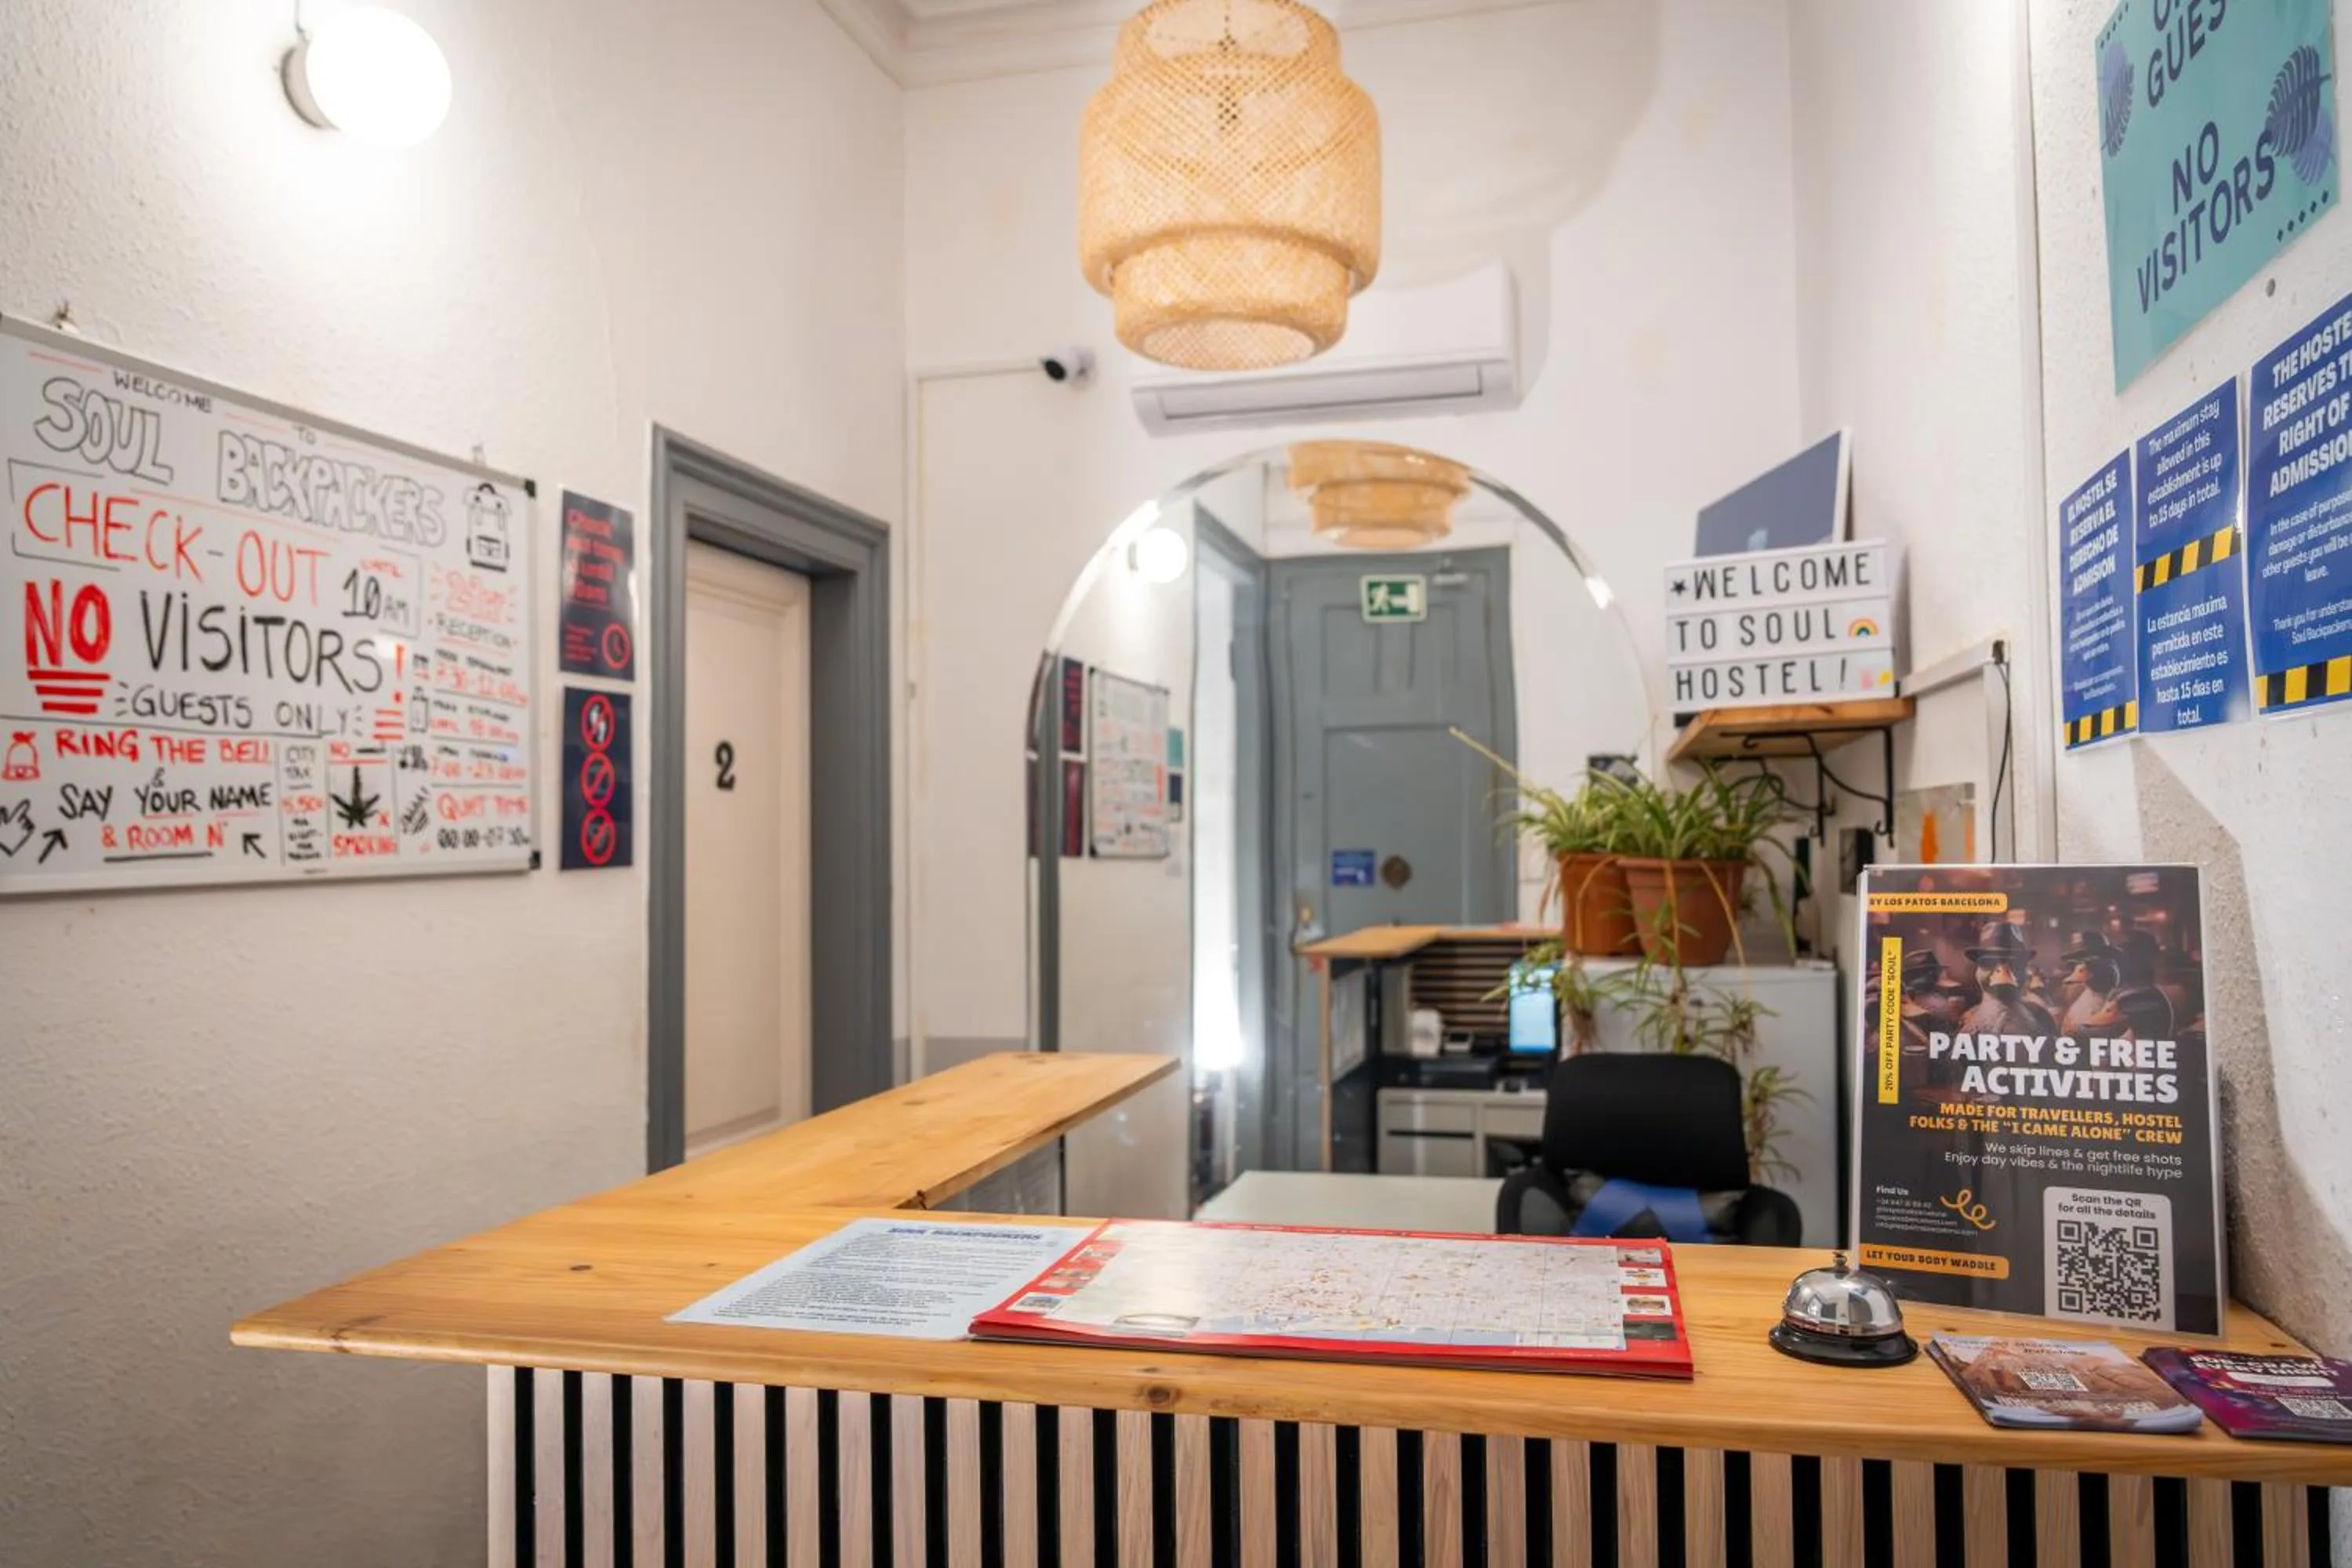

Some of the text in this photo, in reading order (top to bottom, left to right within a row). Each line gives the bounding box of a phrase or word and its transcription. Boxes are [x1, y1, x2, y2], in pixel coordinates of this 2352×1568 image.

[2172, 121, 2220, 215] NO
[2137, 128, 2275, 314] VISITORS
[2273, 348, 2299, 389] THE
[113, 370, 212, 414] WELCOME
[2263, 361, 2337, 430] RESERVES
[2200, 399, 2220, 423] stay
[2279, 392, 2350, 456] RIGHT OF
[33, 376, 174, 486] SOUL
[2157, 430, 2211, 477] allowed in this
[216, 430, 447, 547] BACKPACKERS
[2105, 470, 2118, 493] SE
[2147, 452, 2223, 505] establishment is up
[2149, 511, 2158, 528] to
[2158, 504, 2168, 524] 15
[2169, 497, 2188, 520] days
[2188, 490, 2196, 508] in
[2106, 524, 2118, 548] DE
[342, 568, 382, 619] 10
[1694, 552, 1871, 601] WELCOME
[24, 577, 112, 668] NO
[140, 590, 383, 694] VISITORS
[1675, 608, 1836, 652] TO SOUL
[2147, 617, 2157, 633] La
[2157, 604, 2190, 628] estancia
[2152, 623, 2224, 660] permitida en este
[2151, 652, 2216, 681] establecimiento
[2216, 650, 2228, 666] es
[132, 684, 252, 730] GUESTS
[2157, 686, 2180, 704] hasta
[2180, 681, 2190, 699] 15
[2212, 678, 2224, 696] en
[55, 728, 140, 763] RING
[151, 735, 205, 765] THE
[714, 740, 735, 791] 2
[59, 782, 272, 822] SAY YOUR NAME
[102, 824, 118, 848] &
[127, 823, 194, 852] ROOM
[1886, 989, 1895, 1014] CODE
[1886, 1018, 1895, 1047] PARTY
[1929, 1032, 2176, 1069] PARTY & FREE
[1886, 1051, 1894, 1070] OFF
[1885, 1073, 1894, 1091] 20%
[1961, 1065, 2179, 1103] ACTIVITIES
[1909, 1116, 1955, 1130] FOLKS
[1958, 1119, 1967, 1130] &
[1972, 1120, 1999, 1132] THE
[2022, 1123, 2067, 1137] CAME
[2136, 1130, 2183, 1144] CREW
[1940, 1103, 2183, 1128] MADE FOR TRAVELLERS, HOSTEL
[1944, 1152, 2183, 1179] Enjoy day vibes & the nightlife hype
[1985, 1142, 2183, 1166] We skip lines & get free shots
[1876, 1185, 1909, 1196] Find Us
[2072, 1193, 2141, 1207] Scan the QR
[2058, 1203, 2156, 1219] for all the details
[1867, 1250, 1995, 1271] LET YOUR BODY WADDLE
